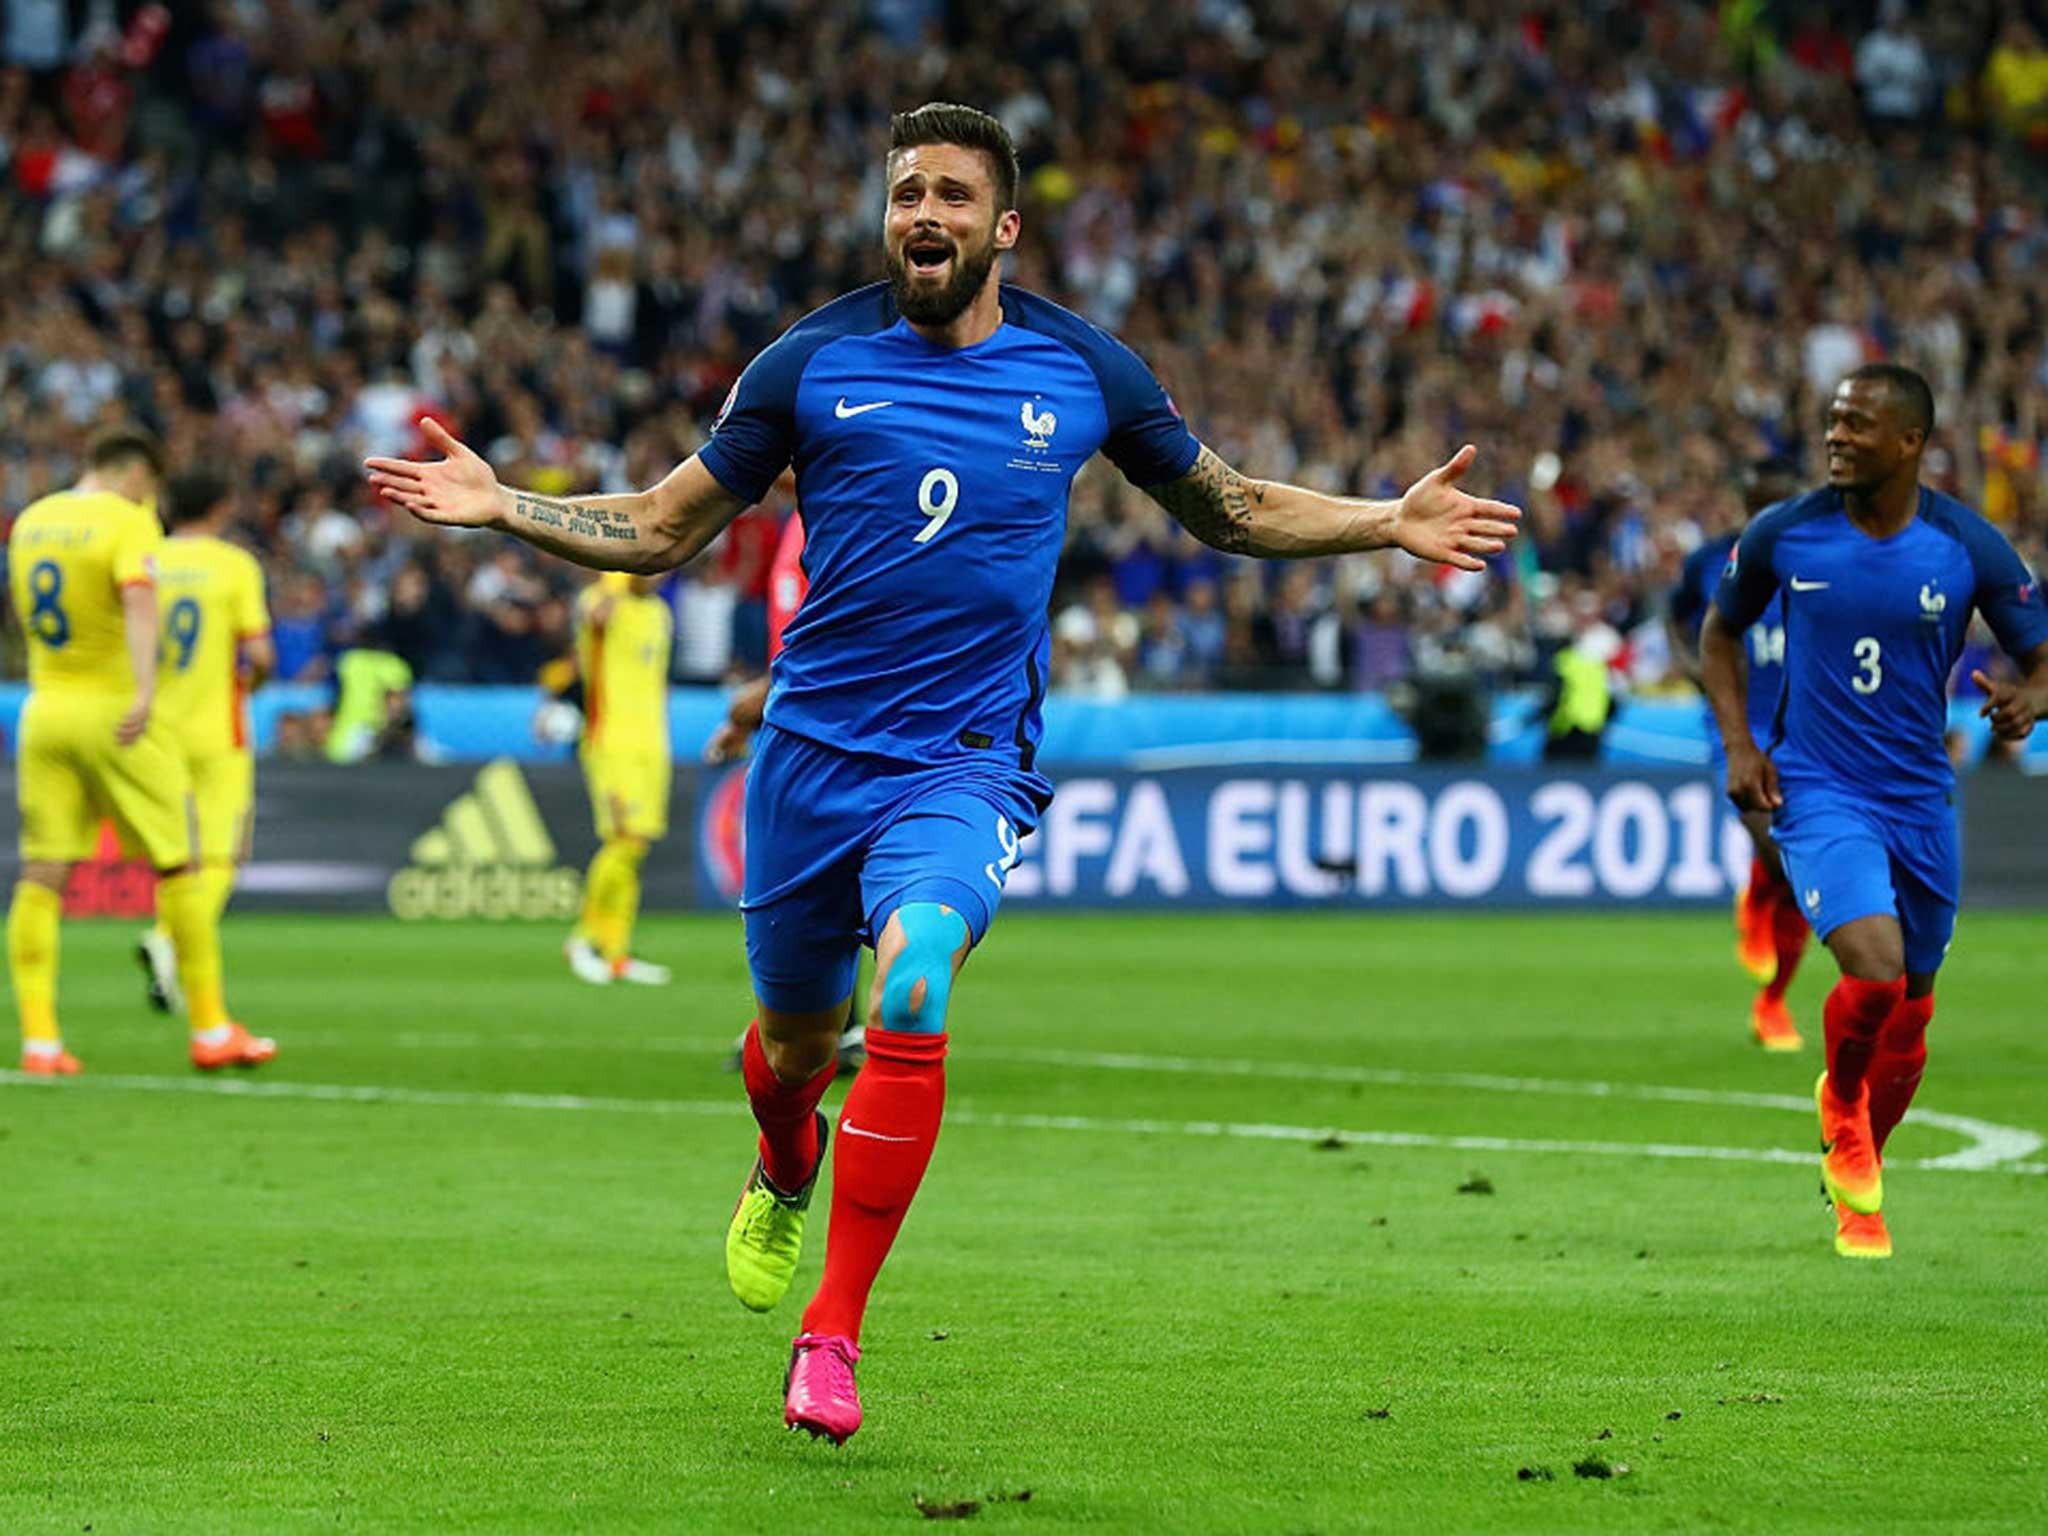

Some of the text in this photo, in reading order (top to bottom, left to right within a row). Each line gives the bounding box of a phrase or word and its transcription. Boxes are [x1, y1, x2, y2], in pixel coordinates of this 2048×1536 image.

[912, 468, 959, 544] 9
[30, 561, 69, 648] 8
[157, 598, 201, 669] 9
[1852, 636, 1882, 694] 3
[1003, 781, 1189, 895] FA
[1207, 780, 1509, 897] EURO
[388, 866, 582, 920] adidas
